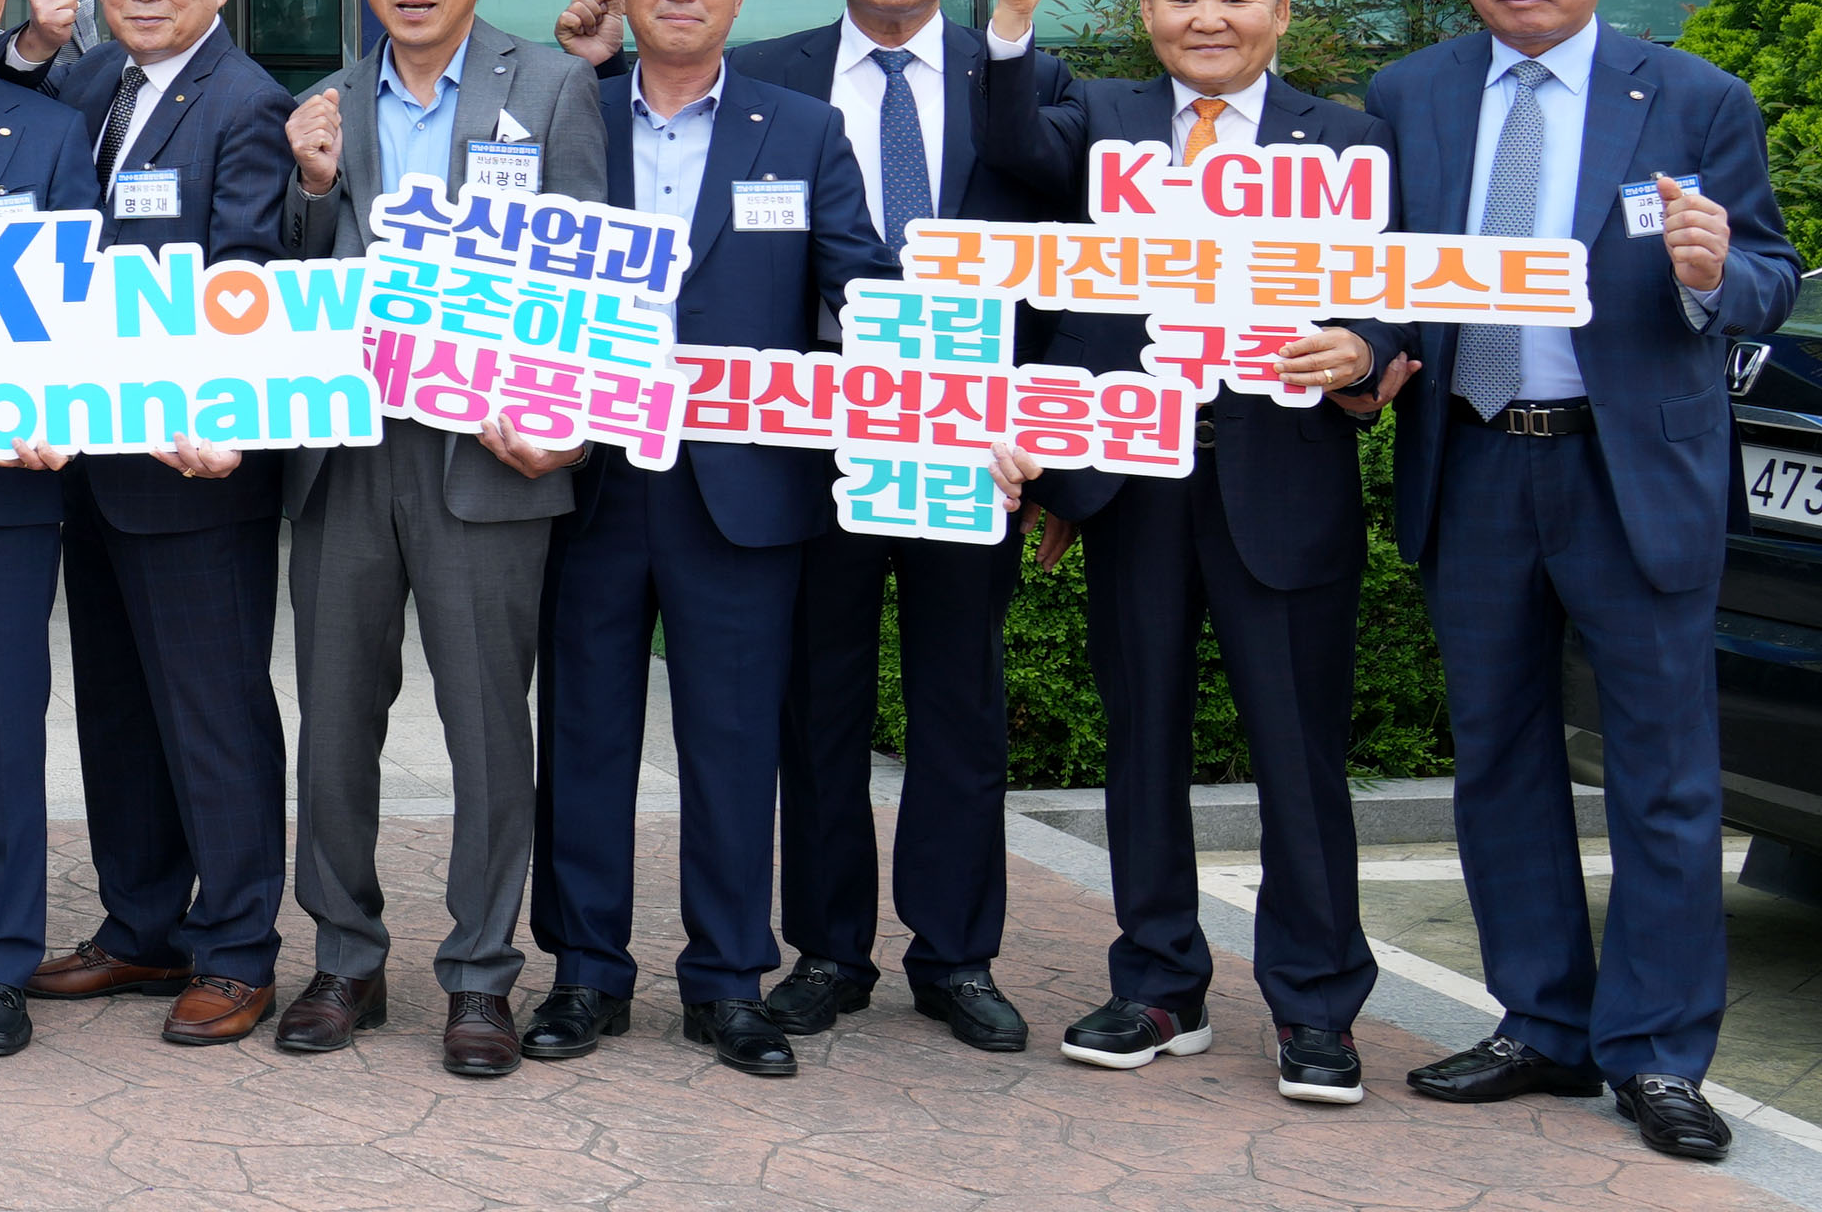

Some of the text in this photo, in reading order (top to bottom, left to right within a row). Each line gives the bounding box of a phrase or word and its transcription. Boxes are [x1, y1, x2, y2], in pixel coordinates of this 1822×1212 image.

[1100, 151, 1373, 221] K-GIM
[381, 185, 679, 294] 수산업과
[911, 229, 1577, 314] 국가전략 클러스트
[112, 252, 367, 338] Now
[368, 254, 661, 370] 공존하는
[852, 290, 1002, 365] 국립
[1153, 323, 1309, 395] 구축
[673, 356, 1184, 467] 김산업진흥원
[845, 456, 995, 533] 건립
